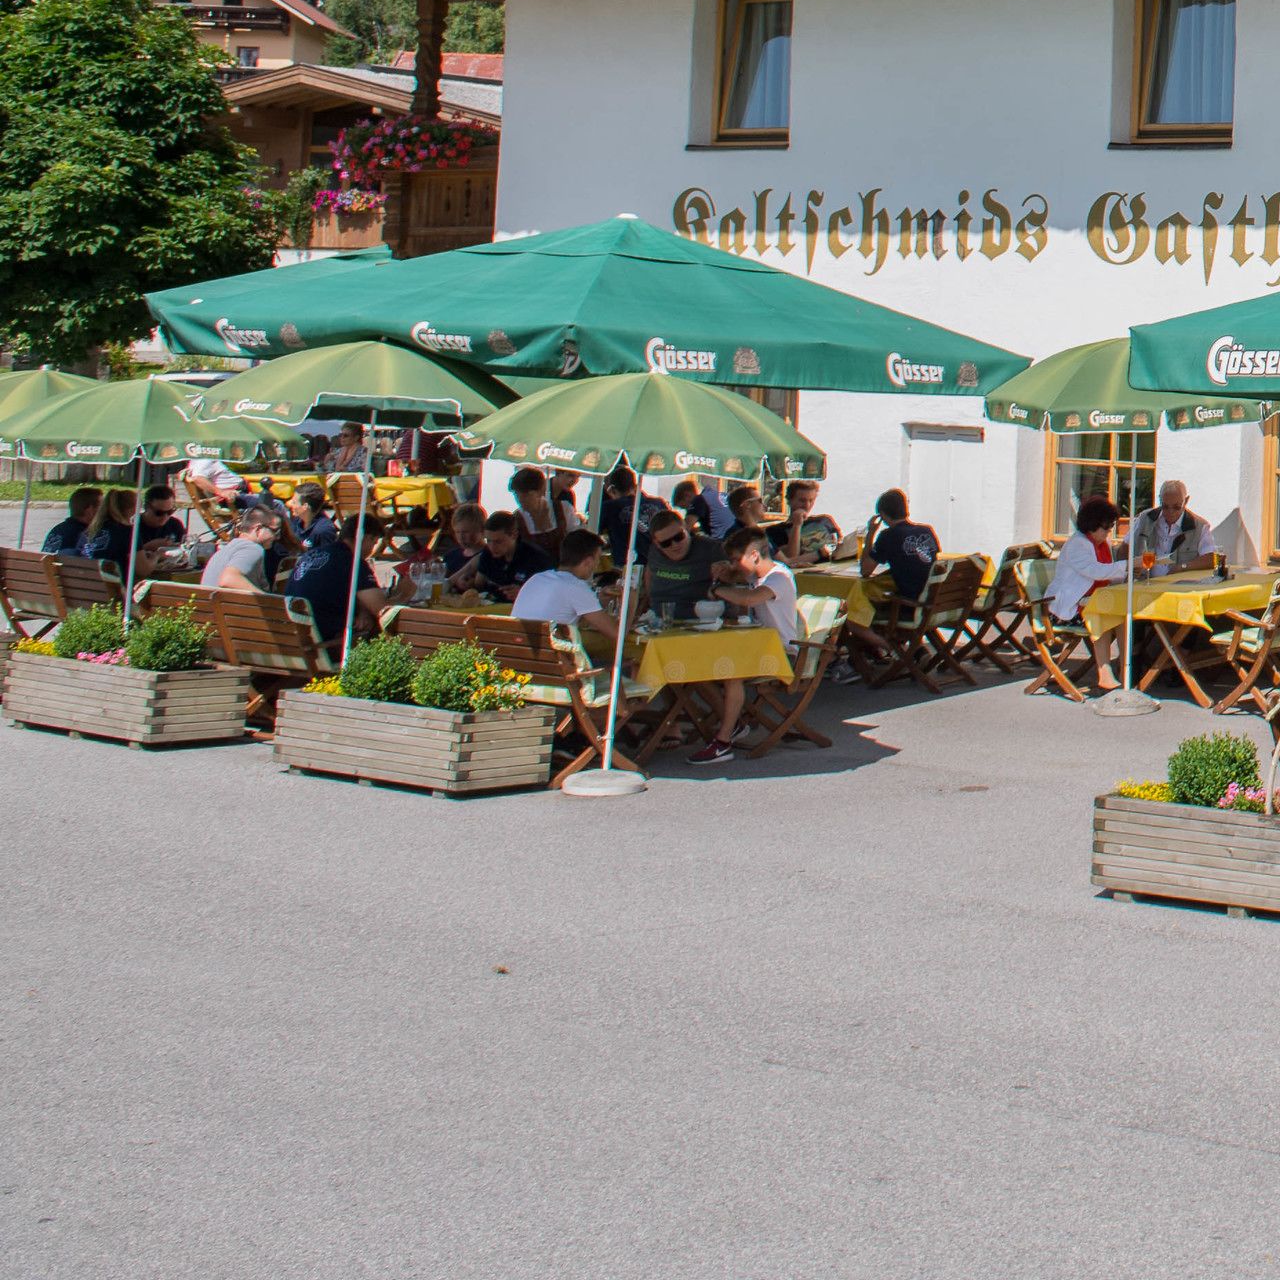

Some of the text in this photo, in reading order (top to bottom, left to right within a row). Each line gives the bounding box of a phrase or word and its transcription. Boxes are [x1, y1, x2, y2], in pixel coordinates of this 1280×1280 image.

[646, 337, 717, 374] Gösser
[886, 352, 945, 387] Gösser
[1089, 408, 1126, 428] Gösser
[1194, 404, 1225, 423] Gösser
[536, 442, 578, 462] Gösser
[674, 450, 718, 470] Gösser
